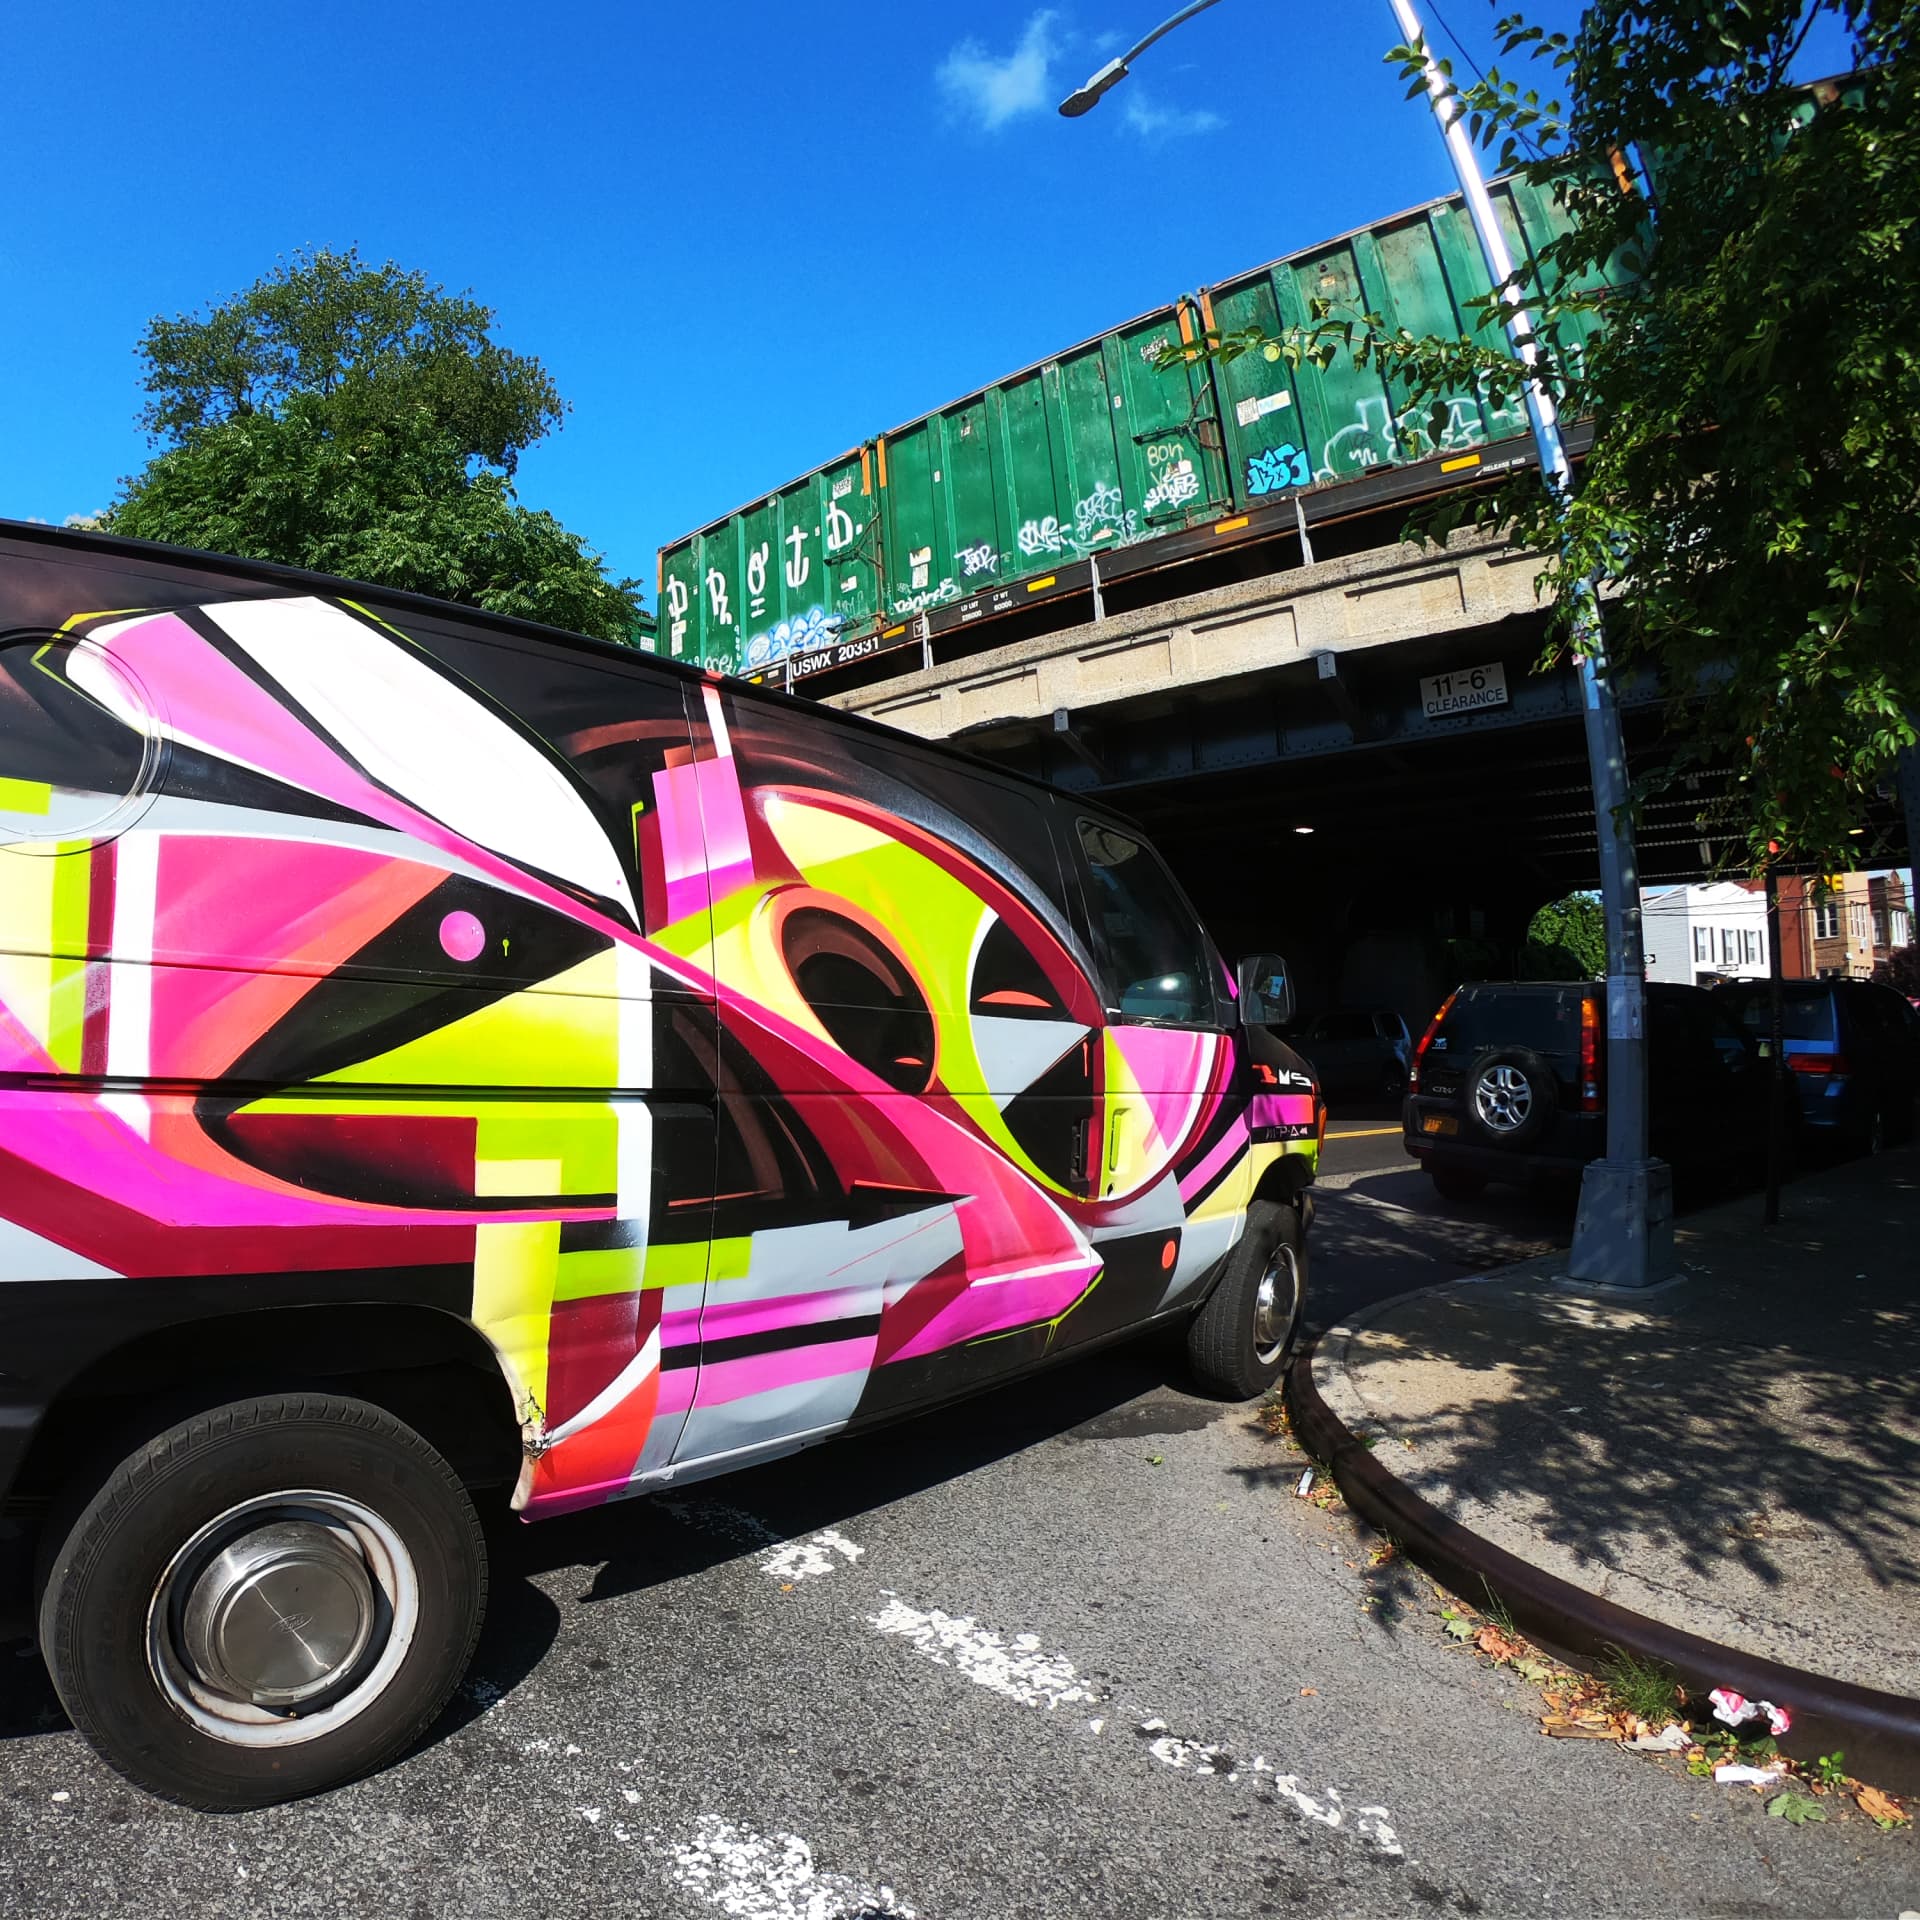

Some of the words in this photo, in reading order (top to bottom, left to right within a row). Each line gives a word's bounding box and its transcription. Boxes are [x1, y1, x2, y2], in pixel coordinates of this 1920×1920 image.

[793, 651, 832, 677] USWX
[838, 637, 879, 662] 20331
[1427, 688, 1504, 714] CLEARANCE
